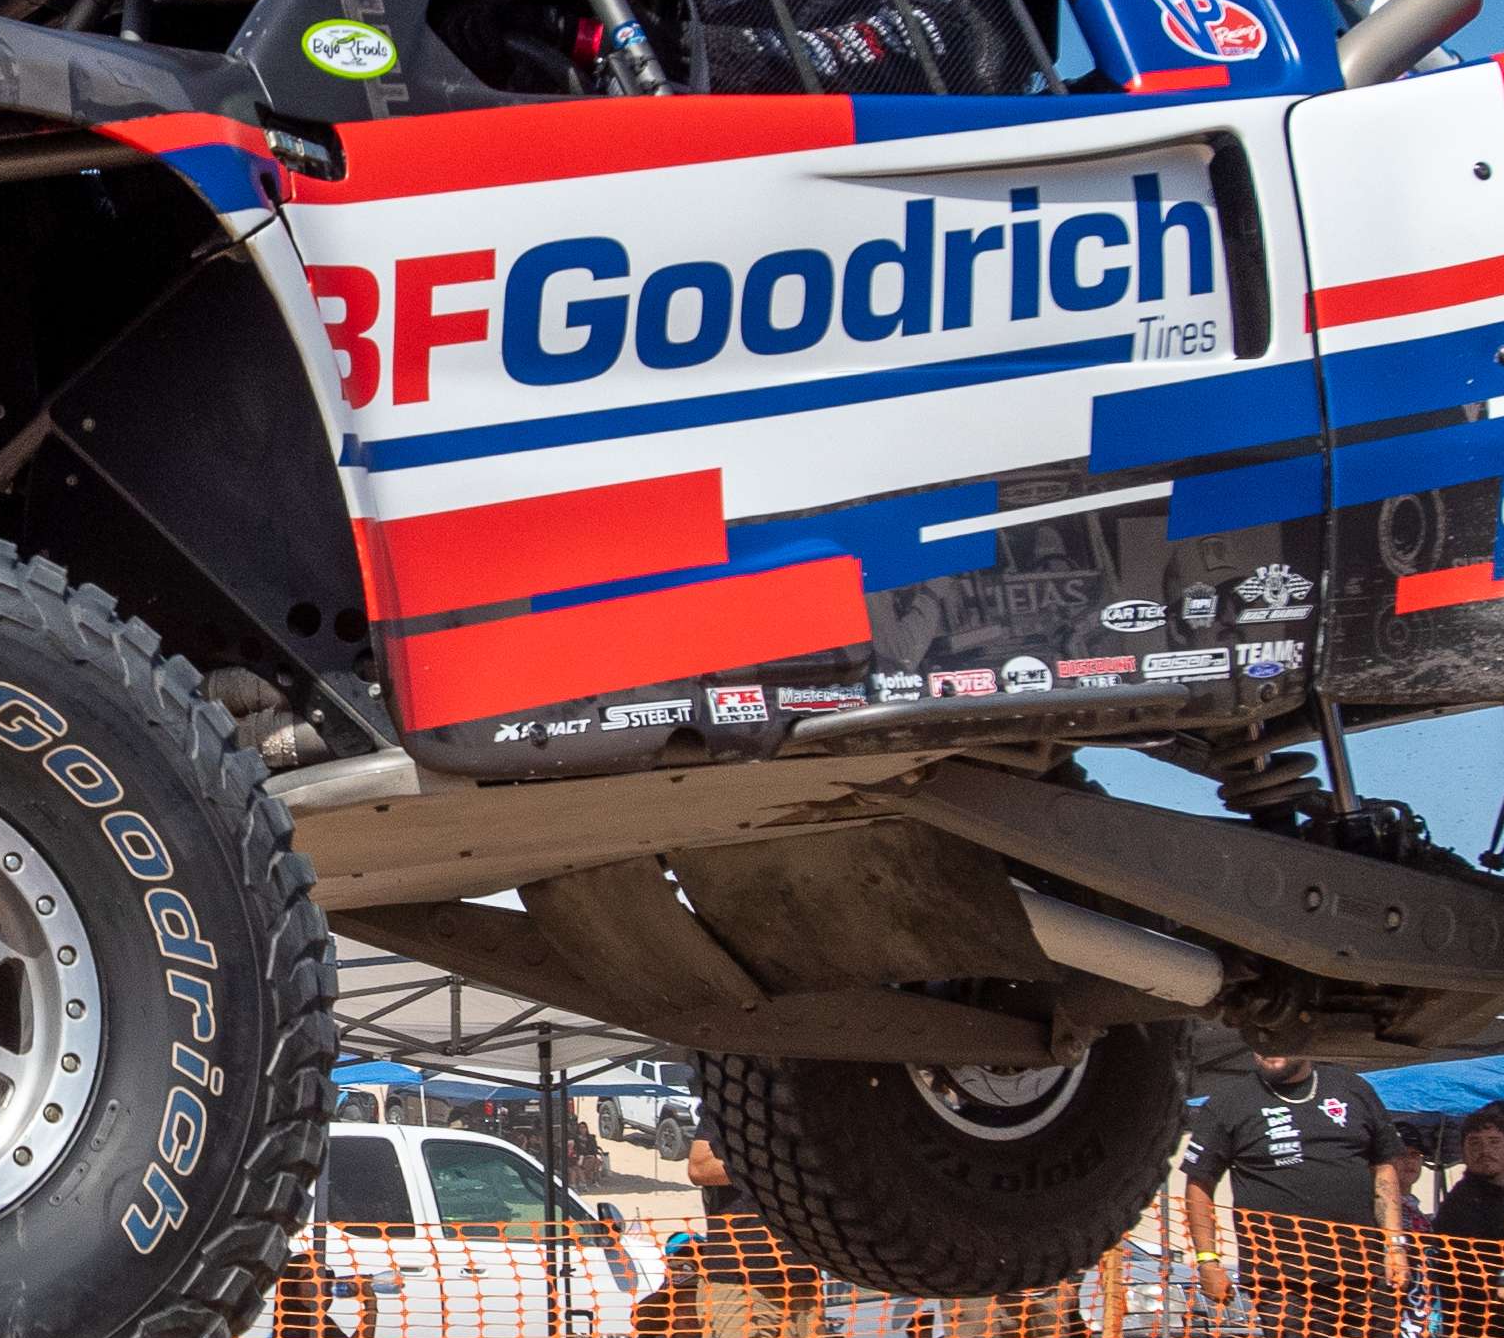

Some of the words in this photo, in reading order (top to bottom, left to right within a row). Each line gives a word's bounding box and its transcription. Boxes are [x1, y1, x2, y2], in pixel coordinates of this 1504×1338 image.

[1138, 315, 1217, 361] Tires
[1102, 607, 1135, 621] KAR
[1136, 605, 1168, 619] TEK
[873, 671, 924, 690] Motive
[629, 706, 692, 728] STEEL-IT
[717, 712, 767, 722] ENDS
[727, 704, 764, 713] ROD
